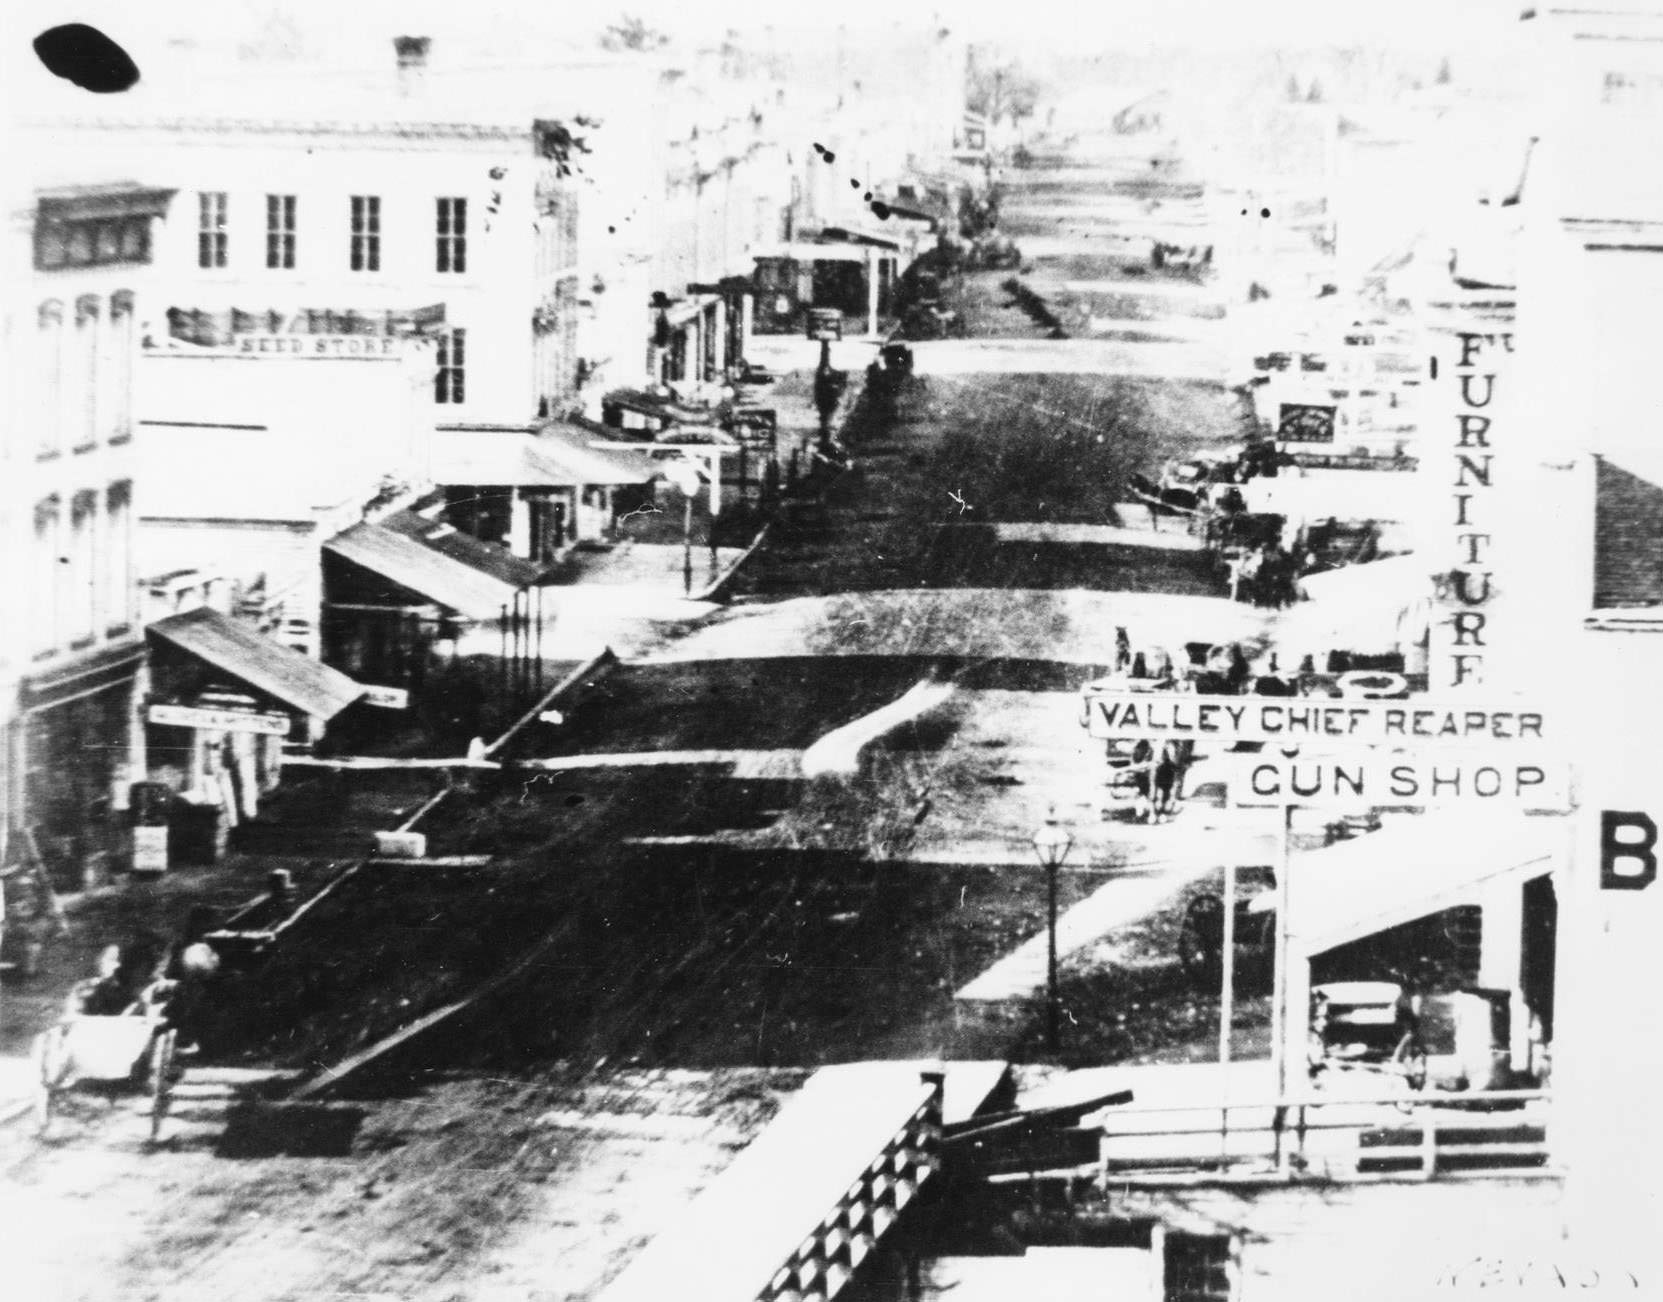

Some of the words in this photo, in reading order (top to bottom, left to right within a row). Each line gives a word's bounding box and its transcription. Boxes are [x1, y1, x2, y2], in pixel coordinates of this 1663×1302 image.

[240, 337, 303, 353] SEED
[315, 337, 393, 354] STORE
[1450, 332, 1497, 688] FURNITURE
[1099, 702, 1246, 732] VALLEY
[1261, 706, 1371, 735] CHIEF
[1385, 710, 1543, 738] REAPER
[1251, 764, 1365, 797] GUN
[1389, 766, 1546, 798] SHOP
[1600, 809, 1658, 891] B
